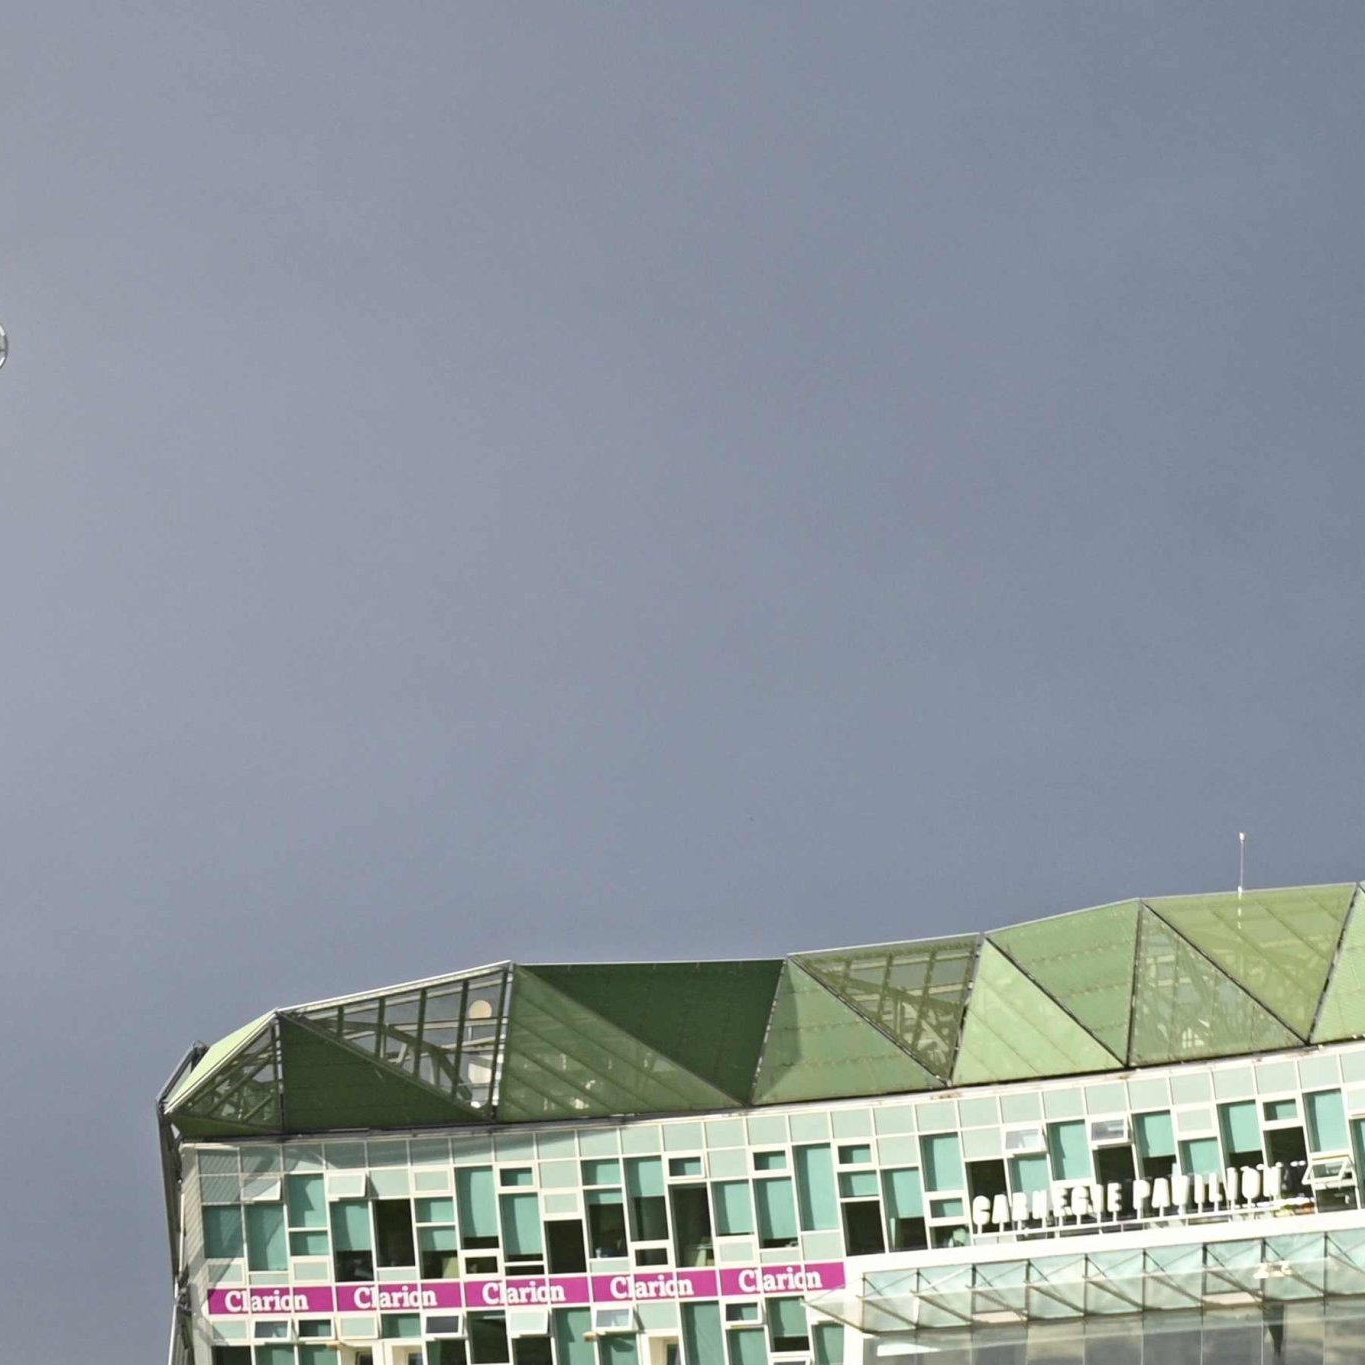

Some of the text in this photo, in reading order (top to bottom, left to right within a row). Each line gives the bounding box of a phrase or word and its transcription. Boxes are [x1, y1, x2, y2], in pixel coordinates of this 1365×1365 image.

[482, 1282, 566, 1307] Clarion
[610, 1277, 694, 1302] Clarion
[739, 1269, 822, 1295] Clarion
[226, 1290, 308, 1314] Clarion
[354, 1286, 437, 1310] Clarion
